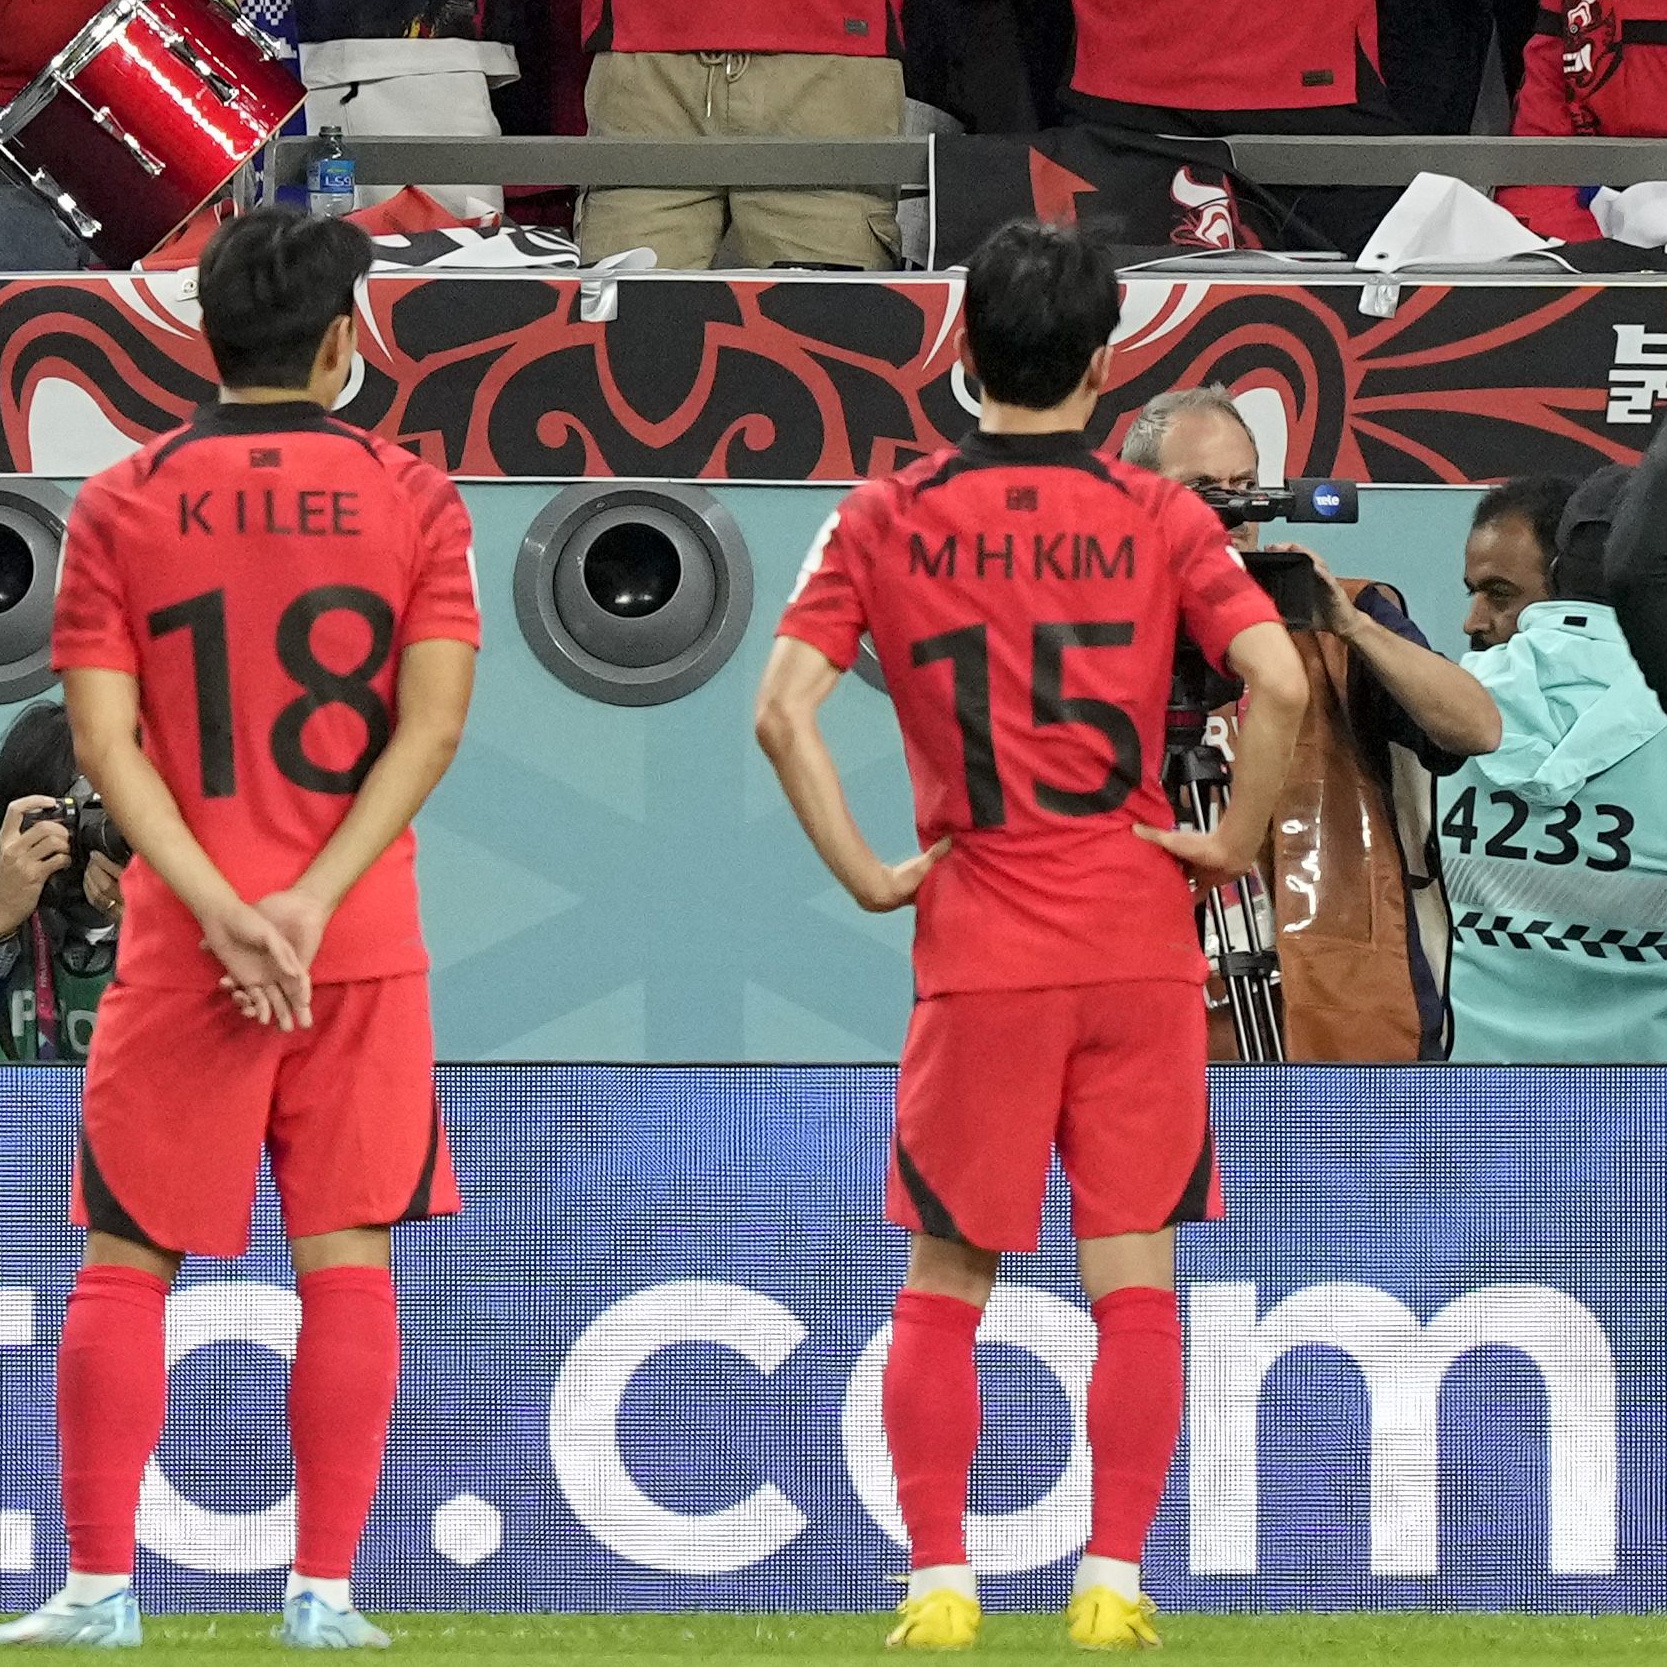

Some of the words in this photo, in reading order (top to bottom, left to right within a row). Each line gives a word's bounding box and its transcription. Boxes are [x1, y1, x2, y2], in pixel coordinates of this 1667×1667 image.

[177, 489, 213, 535] K
[236, 489, 248, 535] I
[263, 488, 361, 536] LEE
[907, 533, 957, 580] M
[975, 533, 1015, 580] H
[1034, 533, 1136, 581] KIM
[146, 582, 395, 800] 18
[909, 620, 1143, 830] 15
[1440, 785, 1635, 873] 4233
